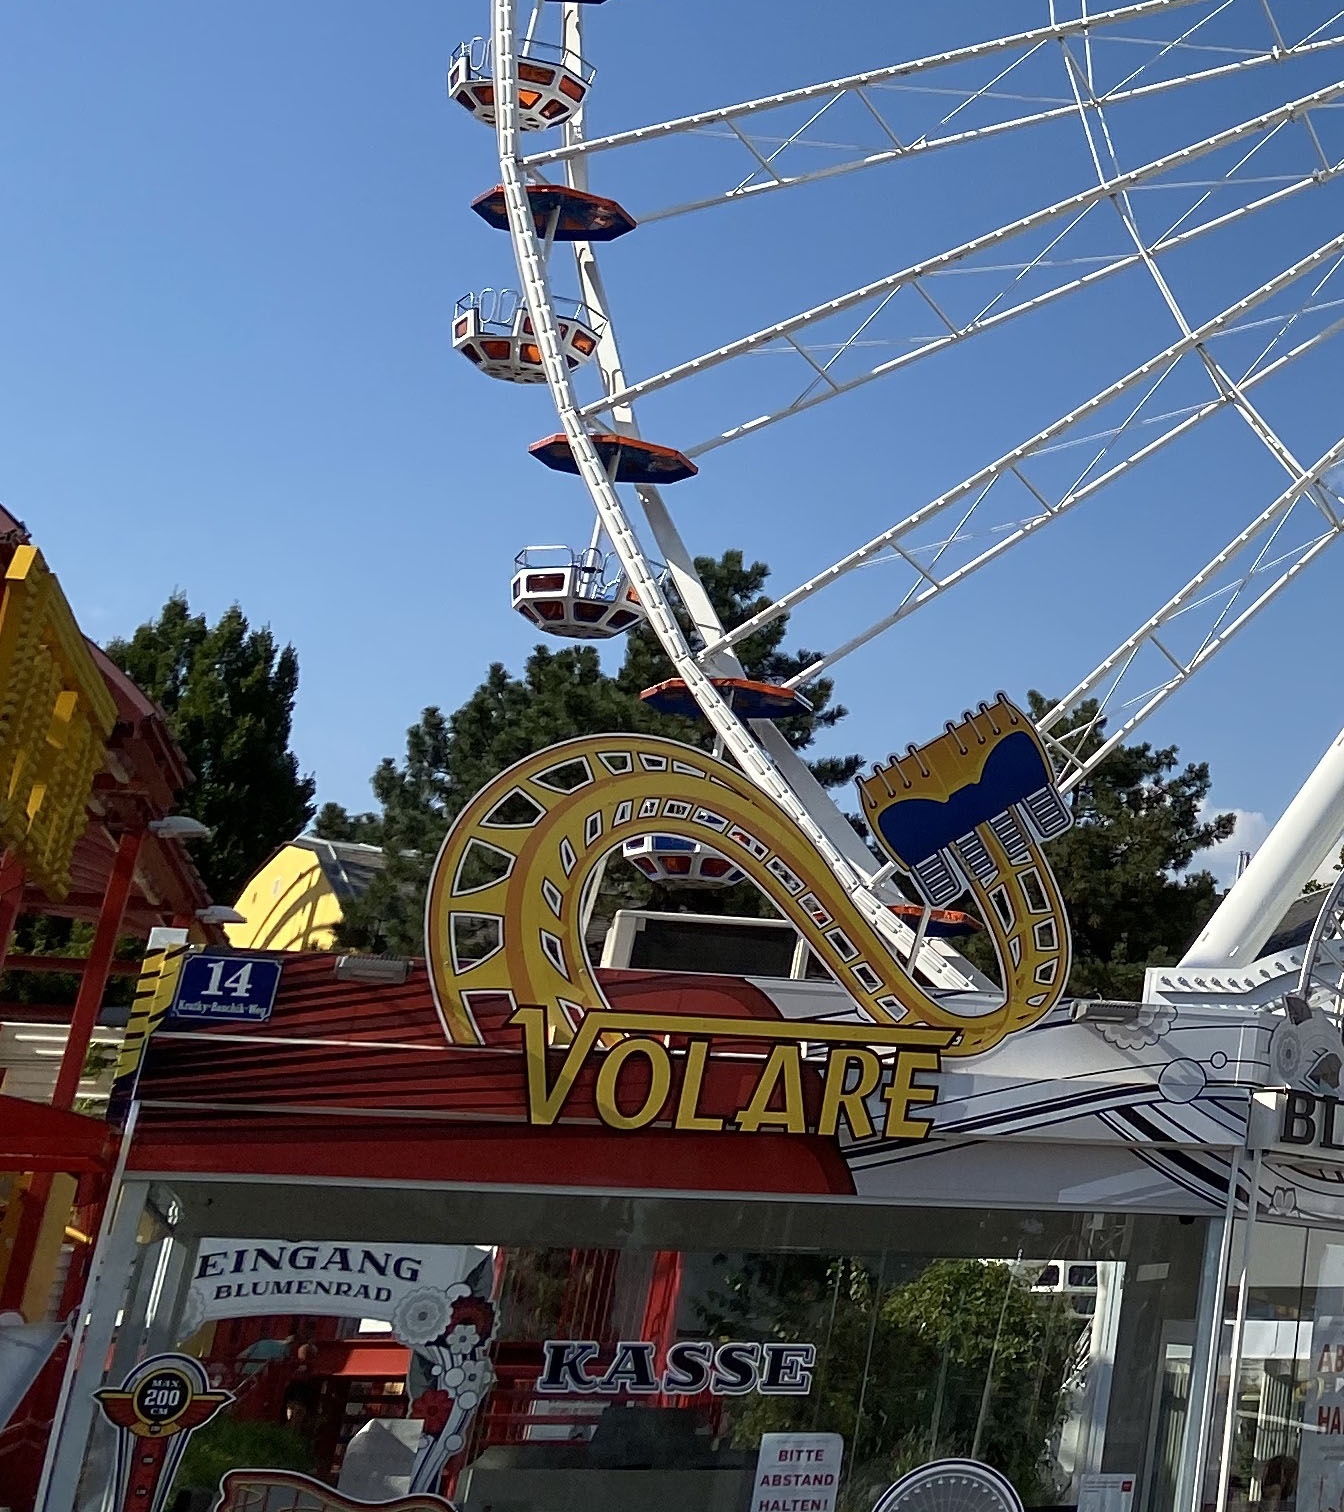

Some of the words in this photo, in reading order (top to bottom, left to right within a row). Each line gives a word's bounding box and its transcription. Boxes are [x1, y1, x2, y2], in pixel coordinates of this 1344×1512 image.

[200, 960, 254, 997] 14
[508, 1006, 958, 1140] VOLARE
[195, 1246, 422, 1282] EINGANG
[213, 1280, 392, 1302] BLUMENRAD
[537, 1341, 816, 1395] KASSE
[144, 1389, 180, 1406] 200
[779, 1449, 824, 1462] BITTE
[761, 1474, 834, 1486] ABSTAND
[759, 1499, 828, 1512] HALTEN!
